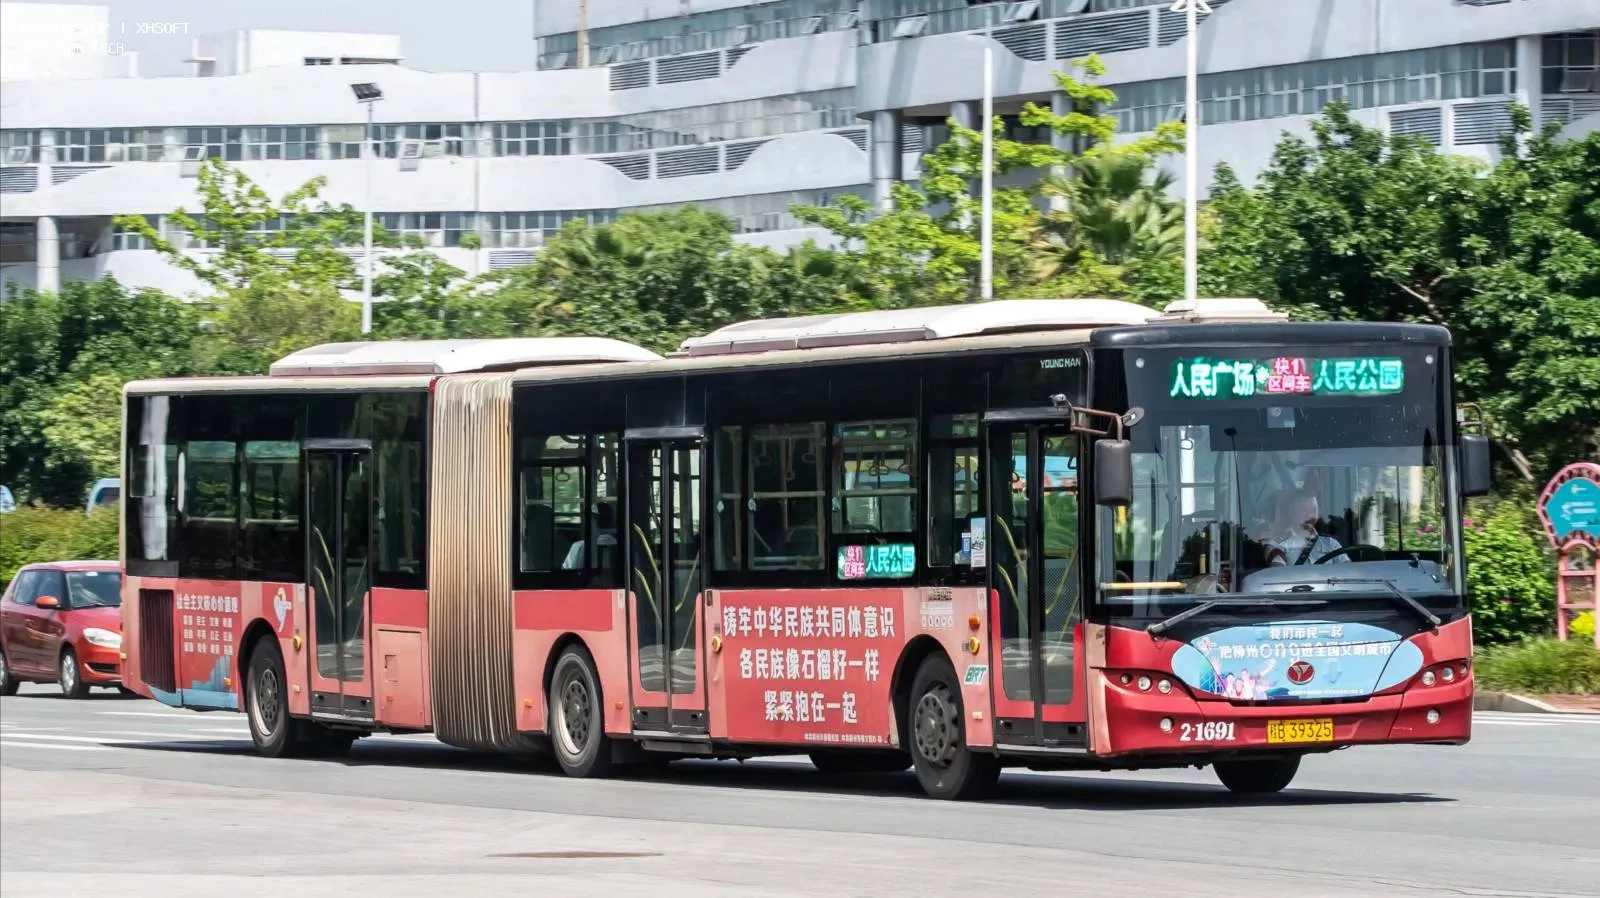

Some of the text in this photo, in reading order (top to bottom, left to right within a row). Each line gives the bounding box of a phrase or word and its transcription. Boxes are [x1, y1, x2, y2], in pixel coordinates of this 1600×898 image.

[1170, 361, 1254, 397] 人民广场
[1268, 375, 1311, 393] 区间车
[1313, 359, 1402, 391] 人民公园
[865, 545, 915, 573] 人民公园
[723, 605, 896, 638] 铸牢中华民族共同体意识
[739, 647, 880, 682] 各民族像石榴籽一样
[965, 666, 988, 683] BRT
[764, 690, 859, 724] 紧紧抱在一起
[1290, 721, 1331, 739] 39325
